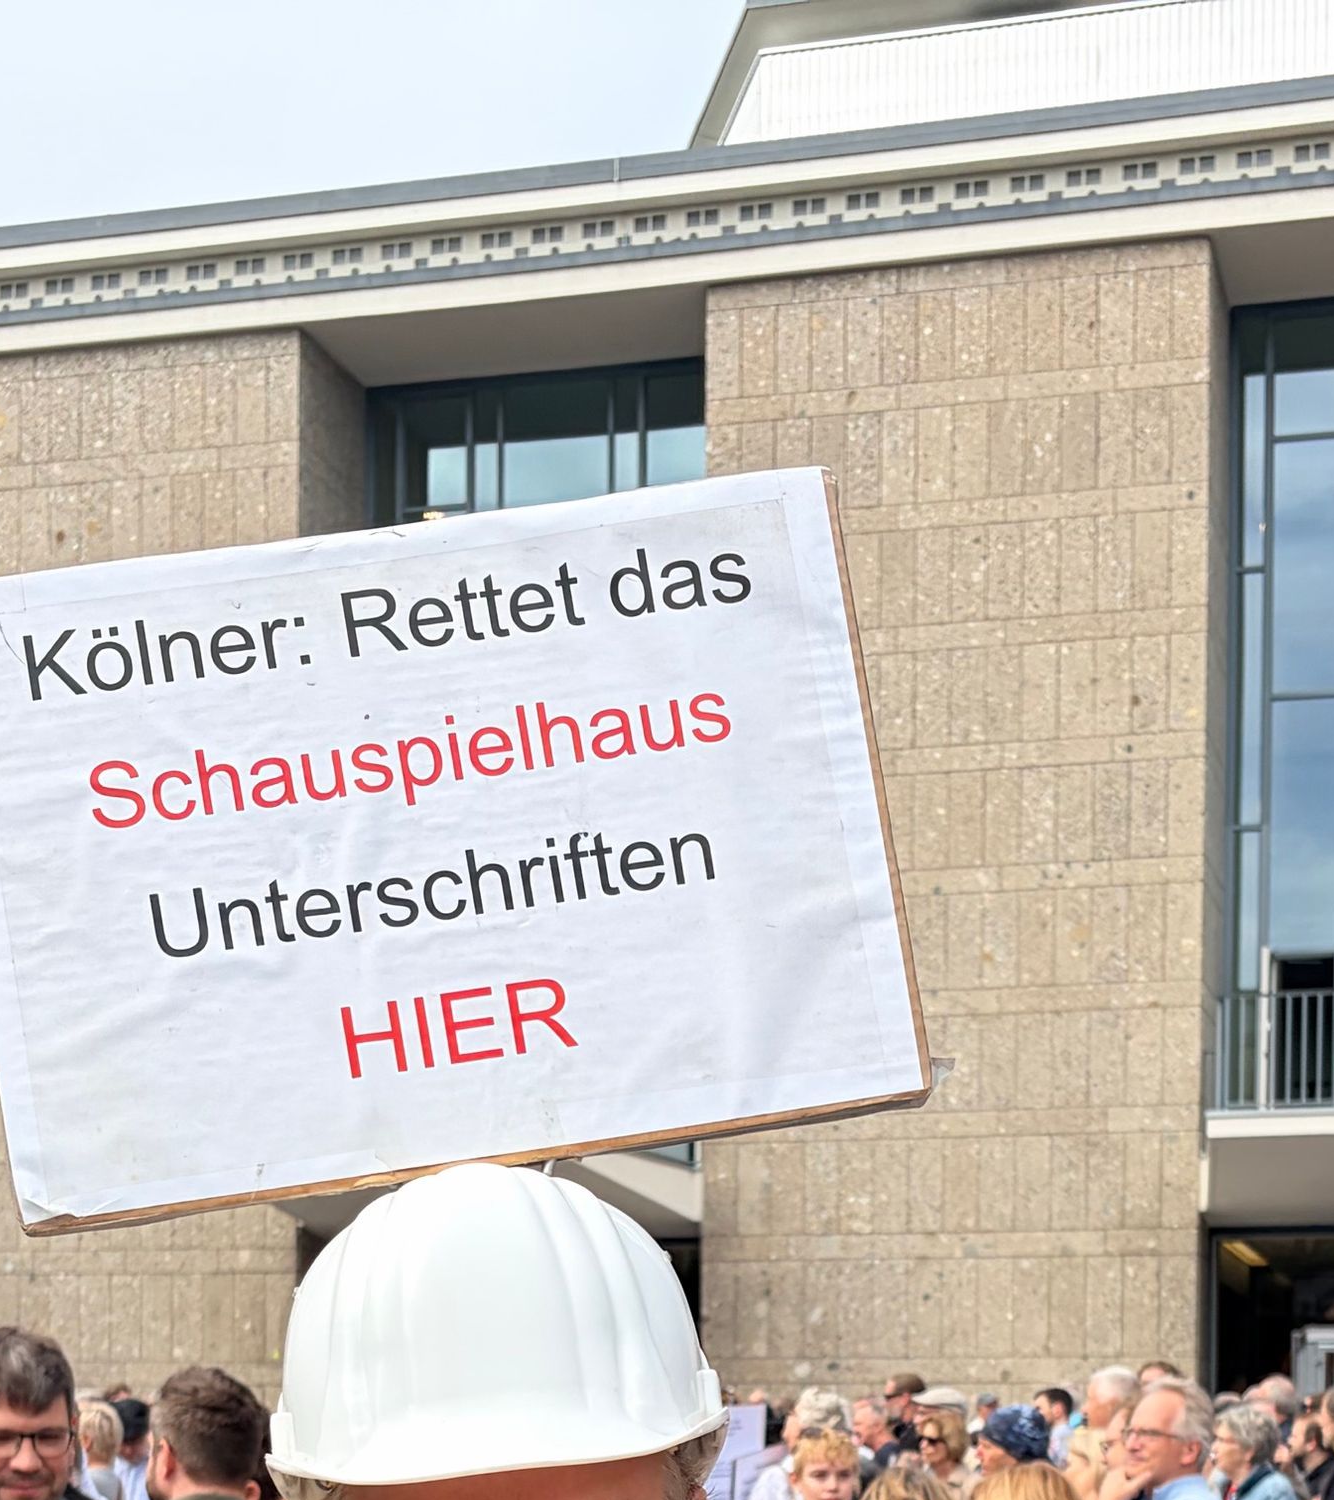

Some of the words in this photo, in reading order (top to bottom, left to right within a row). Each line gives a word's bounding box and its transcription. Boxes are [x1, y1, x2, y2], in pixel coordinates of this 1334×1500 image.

[22, 616, 311, 701] Kölner:
[340, 562, 586, 658] Rettet
[609, 548, 751, 618] das
[89, 693, 731, 829] Schauspielhaus
[149, 832, 715, 958] Unterschriften
[340, 978, 578, 1078] HIER
